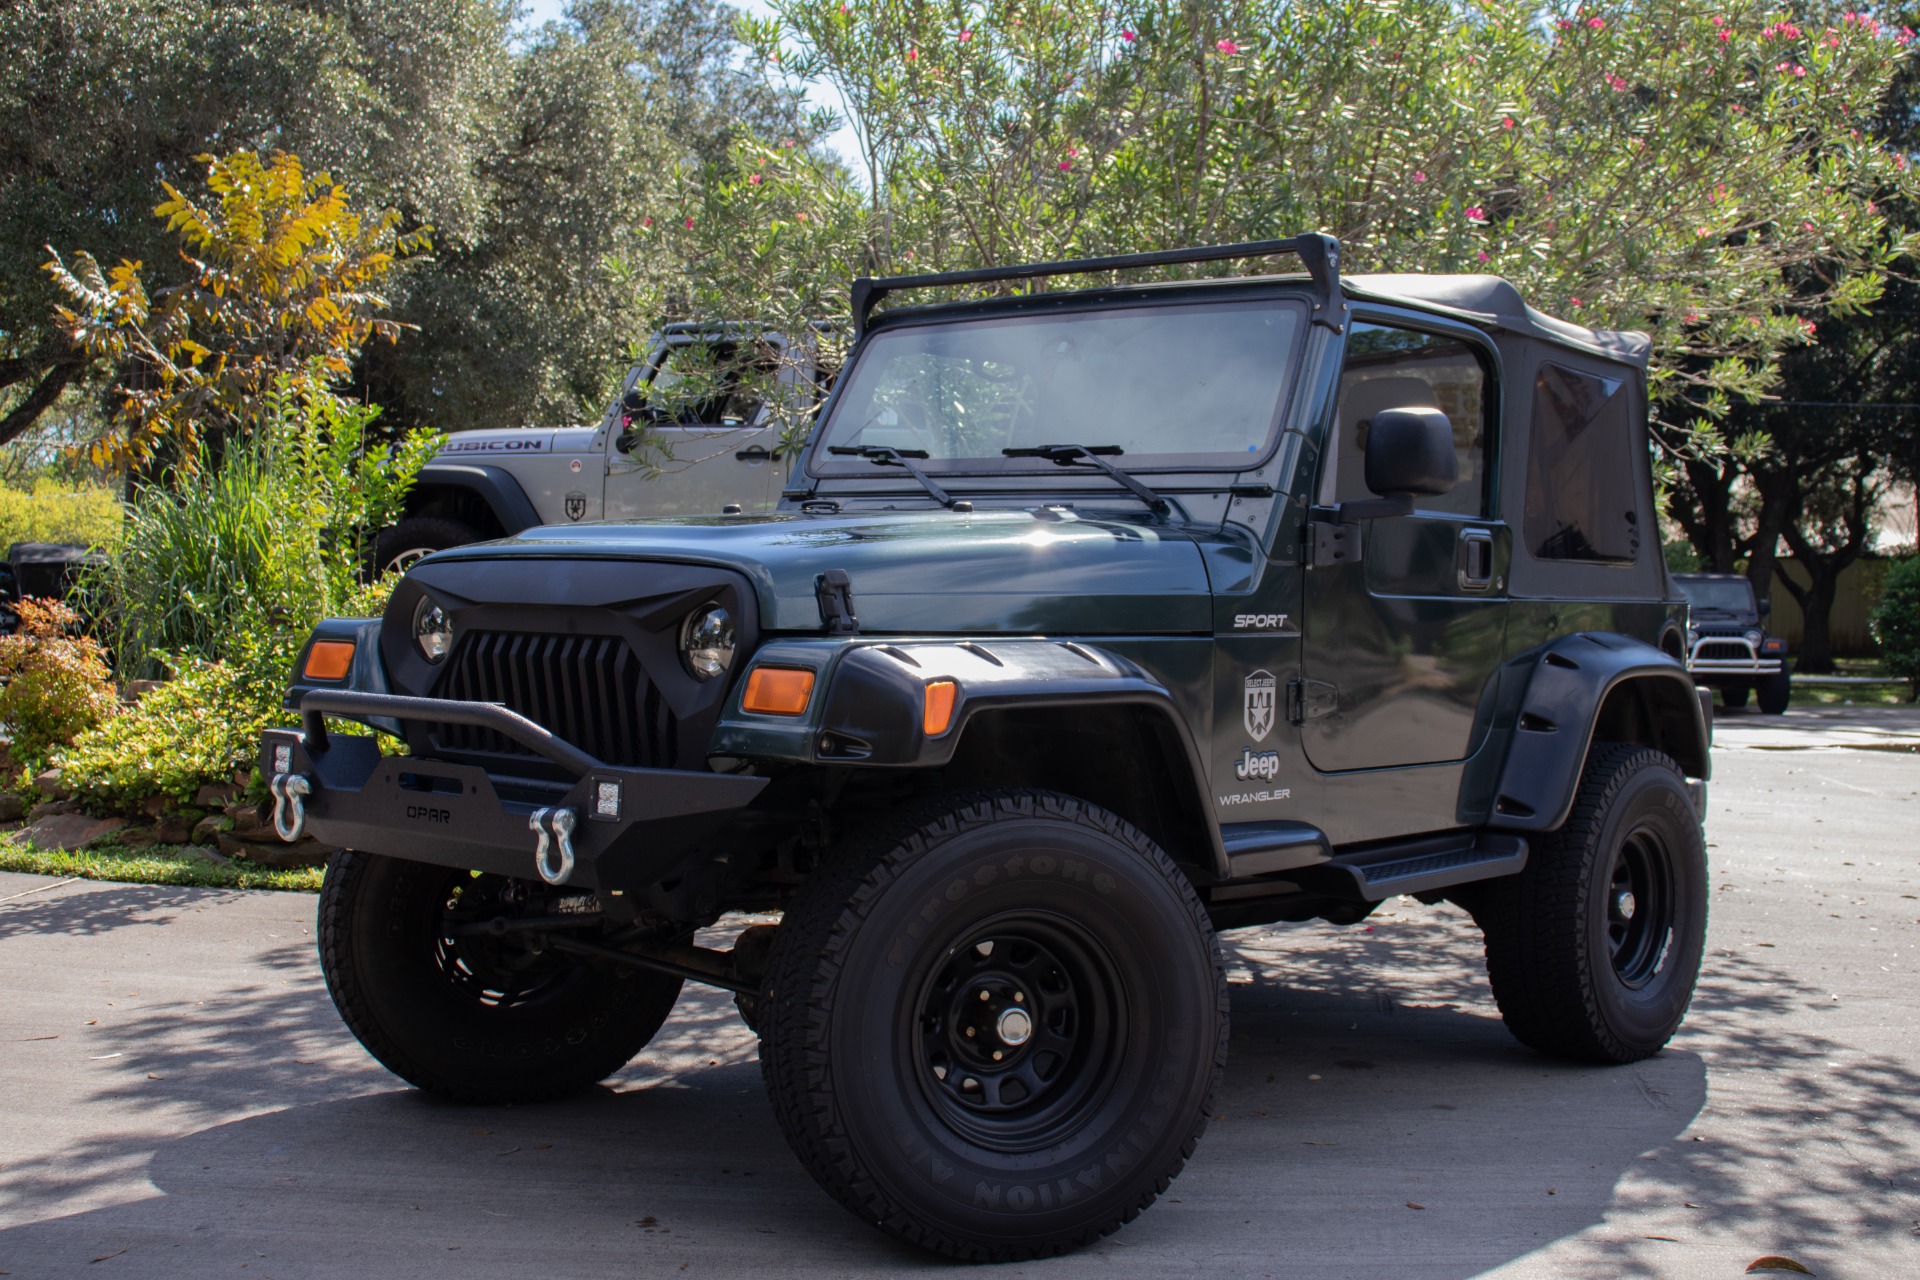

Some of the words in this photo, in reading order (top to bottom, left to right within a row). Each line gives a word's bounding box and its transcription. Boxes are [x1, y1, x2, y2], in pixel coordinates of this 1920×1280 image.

[1233, 614, 1288, 628] SPORT
[1246, 679, 1262, 688] SELECT
[1262, 678, 1275, 687] JEEPS
[1234, 746, 1280, 783] Jeep
[1219, 788, 1291, 806] WRANGLER
[407, 806, 450, 823] OPAR
[888, 854, 1117, 969] Firestone
[972, 1029, 1189, 1211] DESTINATION
